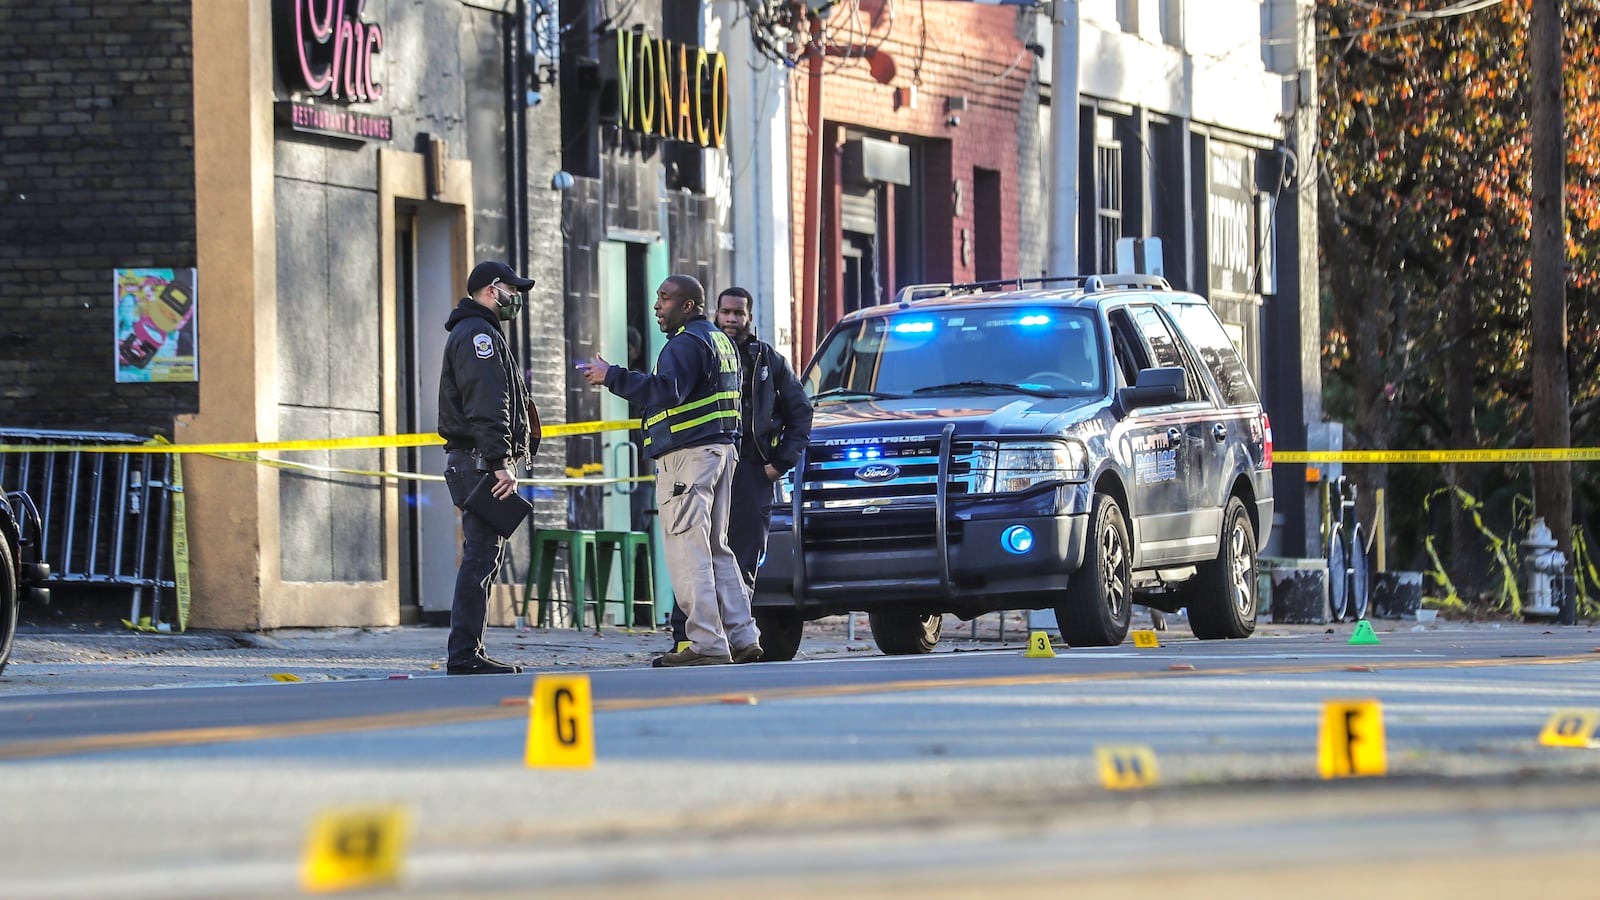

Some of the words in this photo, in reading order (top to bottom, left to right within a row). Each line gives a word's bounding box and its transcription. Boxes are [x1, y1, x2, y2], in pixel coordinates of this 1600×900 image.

[617, 28, 728, 149] MONACO
[293, 104, 347, 132] RESTAURANT
[356, 116, 390, 139] LOUNGE
[648, 412, 665, 424] POLICE
[824, 437, 880, 446] ATLANTA
[882, 435, 926, 444] POLICE
[863, 466, 889, 478] Ford
[1135, 449, 1176, 485] POLICE
[1037, 637, 1046, 650] 3
[1139, 633, 1152, 645] B
[554, 687, 578, 746] G
[1344, 710, 1365, 775] F
